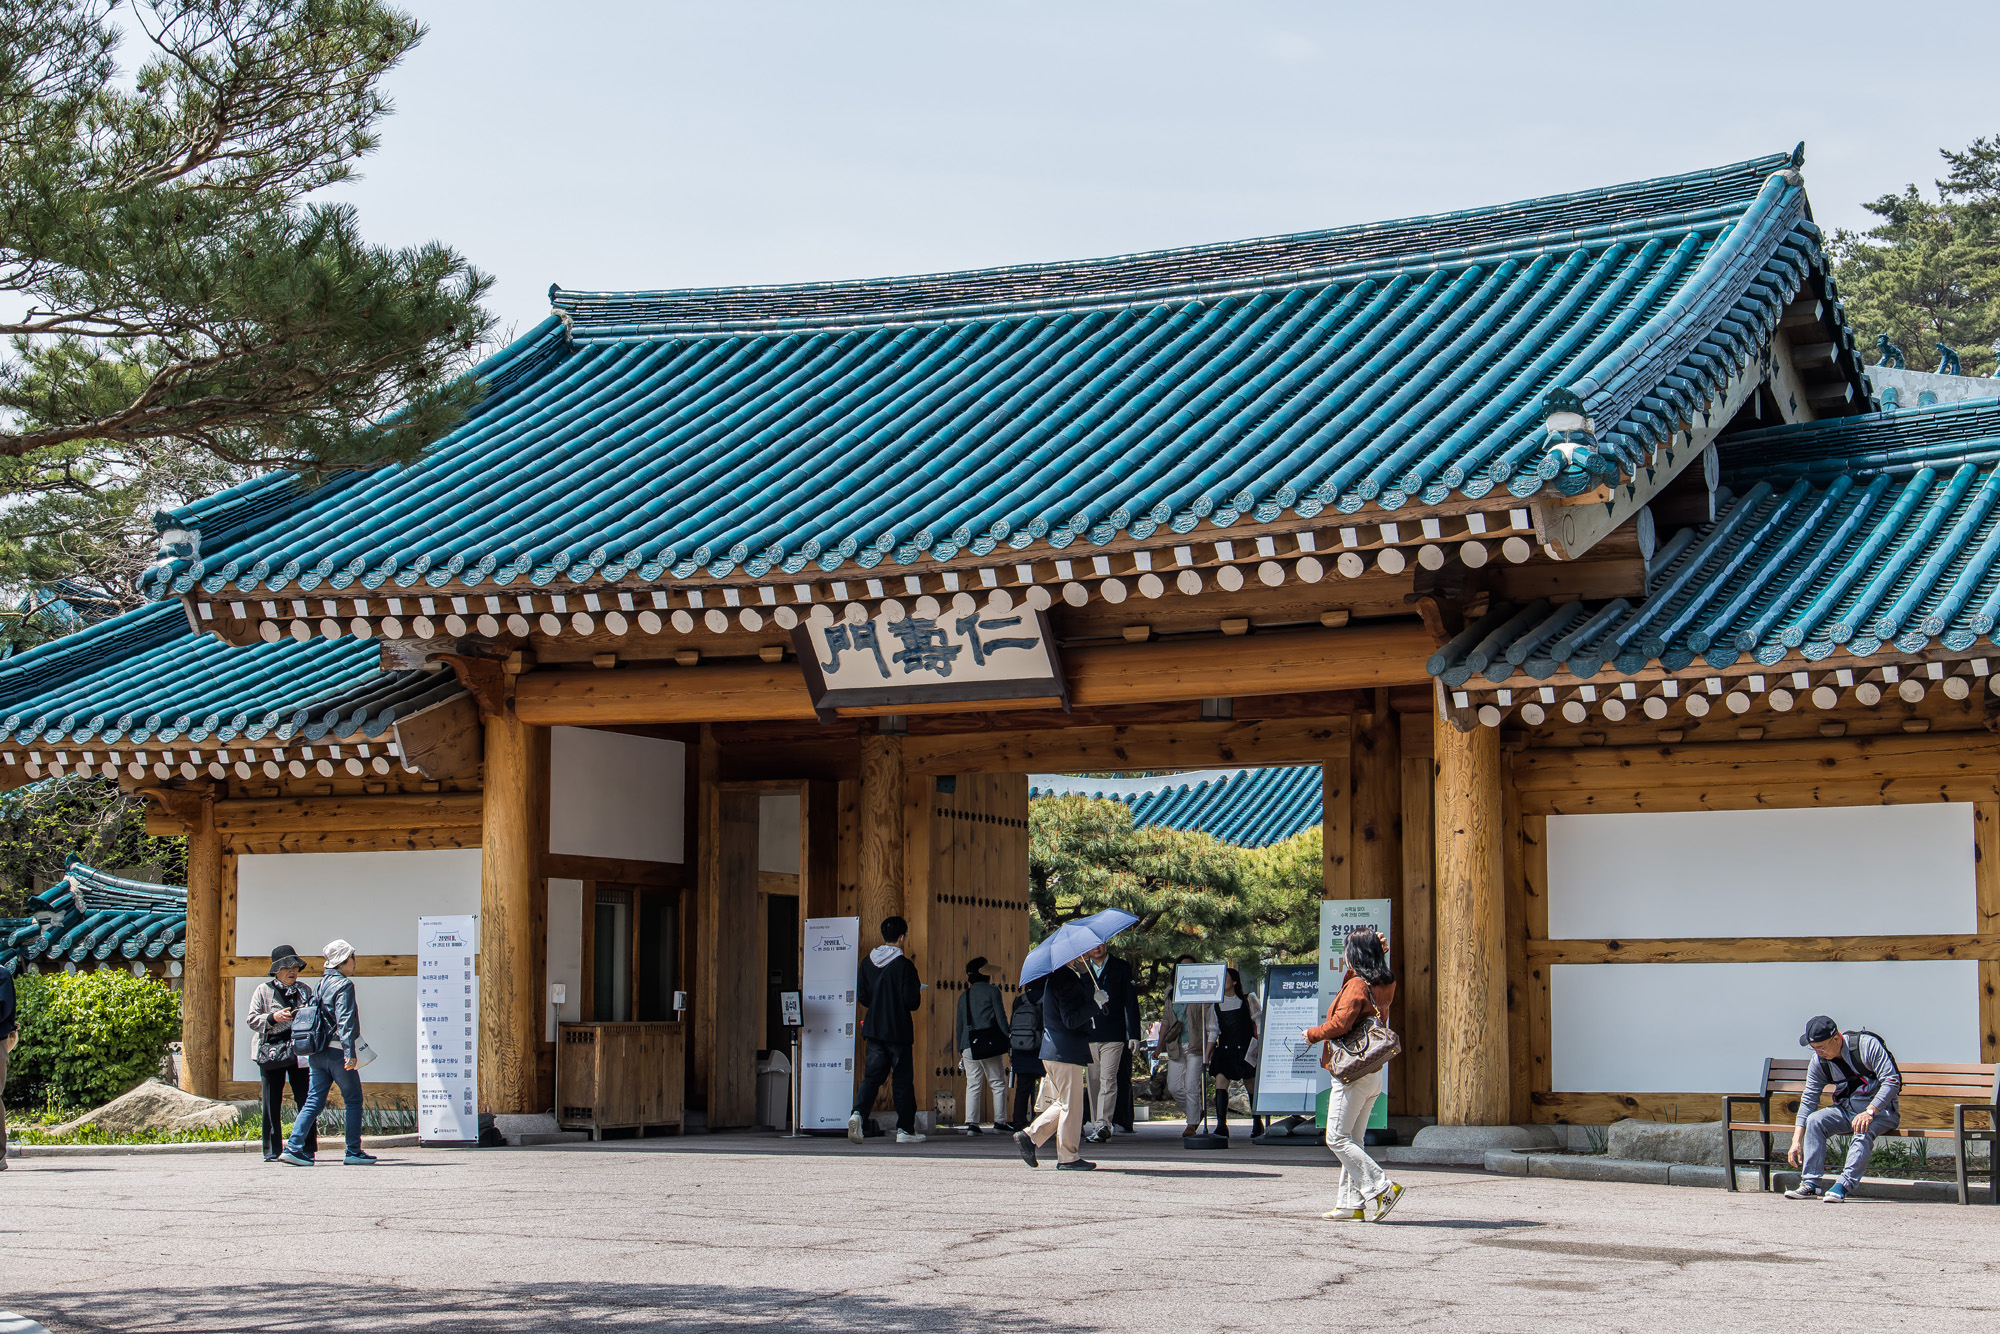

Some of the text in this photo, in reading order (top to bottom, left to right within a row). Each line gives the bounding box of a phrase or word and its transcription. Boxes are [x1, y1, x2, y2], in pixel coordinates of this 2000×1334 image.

[1181, 979, 1217, 990] 입구 출구
[1282, 981, 1295, 990] 관람
